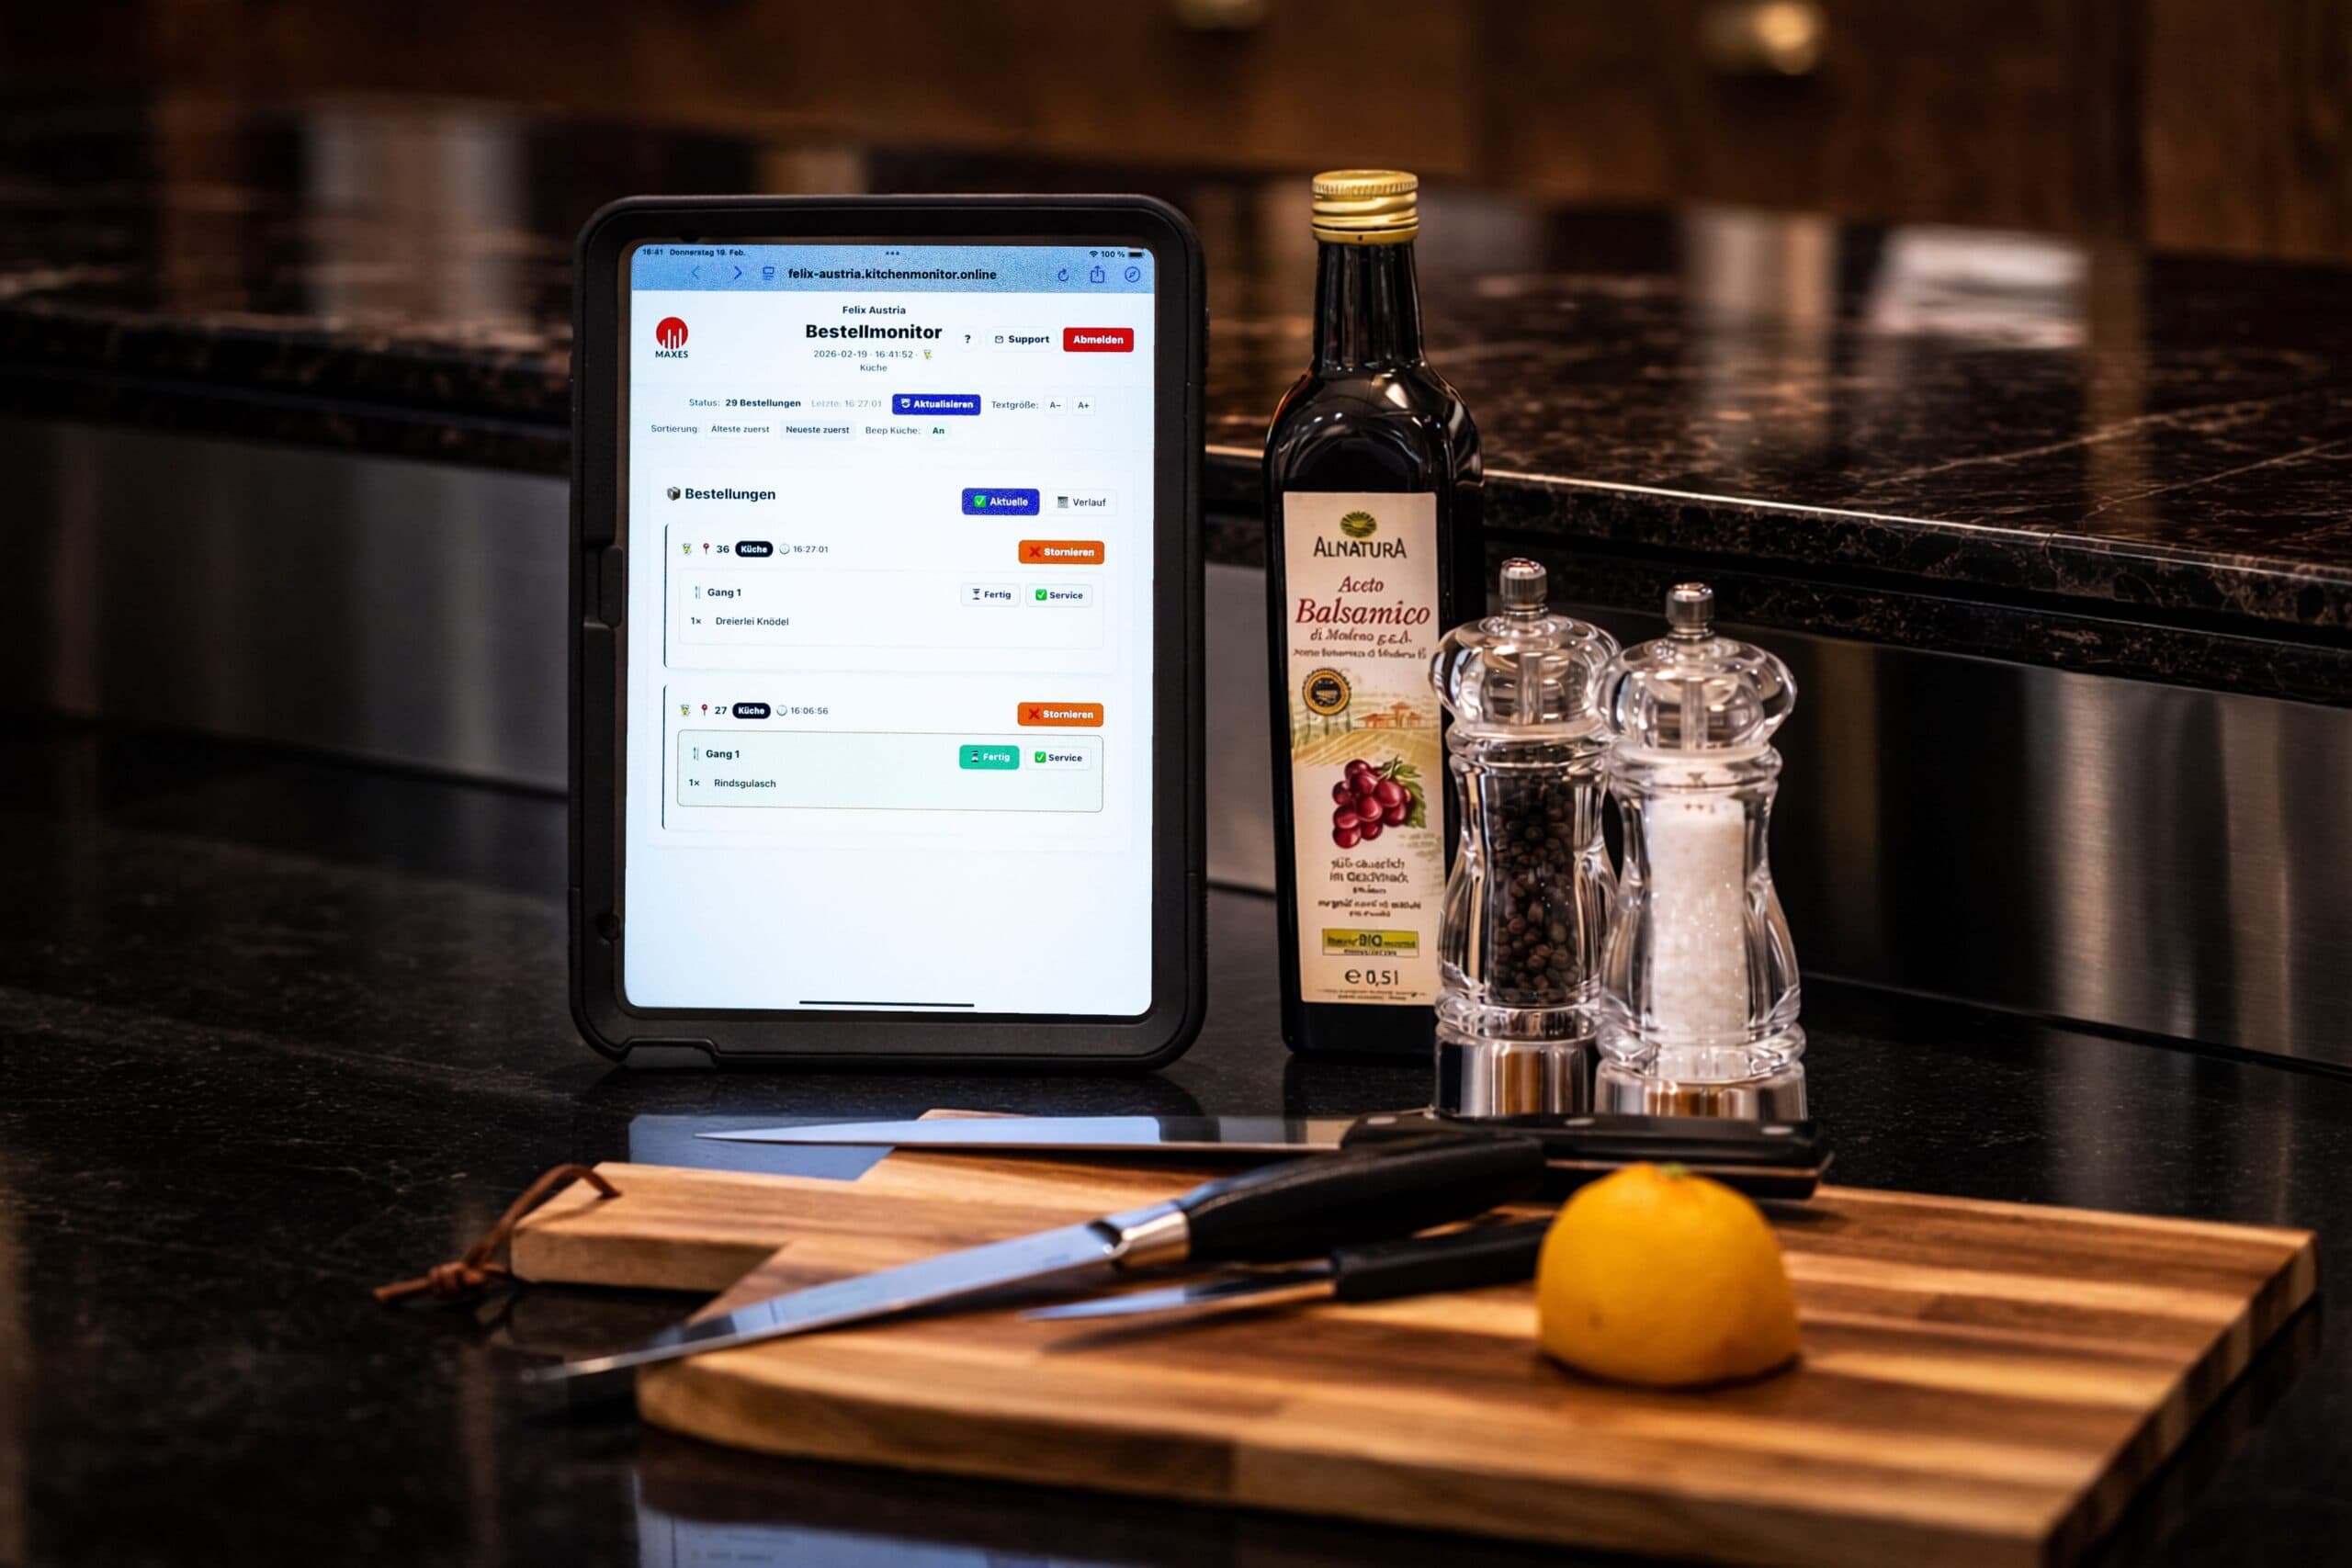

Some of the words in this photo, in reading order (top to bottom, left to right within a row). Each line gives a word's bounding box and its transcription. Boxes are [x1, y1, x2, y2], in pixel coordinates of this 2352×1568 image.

[670, 248, 715, 257] Donnerstag
[1101, 250, 1116, 258] 100
[788, 267, 997, 280] felix-austria.kitchenmonitor.online
[842, 305, 866, 315] Felix
[868, 305, 907, 315] Austria
[806, 323, 943, 340] Bestellmonitor
[965, 334, 971, 344] ?
[1008, 334, 1050, 345] Support
[1073, 334, 1124, 345] Abmelden
[655, 350, 689, 358] MAXES
[813, 350, 868, 358] 2026-02-19
[875, 350, 913, 358] 16:41:52
[859, 363, 888, 372] Küche
[688, 398, 720, 407] Status:
[725, 399, 738, 407] 29
[740, 398, 801, 410] Bestellungen
[913, 400, 974, 410] Aktualisieren
[991, 400, 1039, 411] Textgröße:
[1077, 400, 1090, 410] A+
[650, 424, 700, 434] Sortierung:
[711, 423, 741, 434] Älteste
[743, 425, 770, 434] zuerst
[786, 425, 820, 434] Neueste
[823, 426, 850, 434] zuerst
[865, 426, 888, 436] Beep
[889, 426, 922, 434] Küche:
[932, 426, 945, 434] An
[684, 487, 776, 502] Bestellungen
[989, 497, 1029, 507] Aktuelle
[1073, 497, 1107, 507] Verlauf
[716, 545, 729, 554] 36
[741, 544, 768, 554] Küche
[793, 545, 829, 554] 16:27:01
[1313, 536, 1408, 558] ALNATURA
[1043, 547, 1095, 558] Stornieren
[1337, 575, 1385, 593] Aceto
[707, 588, 734, 598] Gang
[736, 588, 741, 597] 1
[984, 591, 1012, 601] Fertig
[1049, 591, 1083, 600] Service
[1295, 597, 1431, 626] Balsamico
[716, 616, 755, 626] Dreierlei
[757, 616, 789, 626] Knödel
[714, 706, 728, 716] 27
[738, 705, 765, 716] Küche
[790, 706, 829, 715] 16:06:56
[1043, 709, 1094, 719] Stornieren
[706, 750, 733, 760] Gang
[735, 750, 741, 759] 1
[983, 752, 1011, 763] Fertig
[1048, 753, 1083, 762] Service
[714, 778, 777, 789] Rindsgulasch
